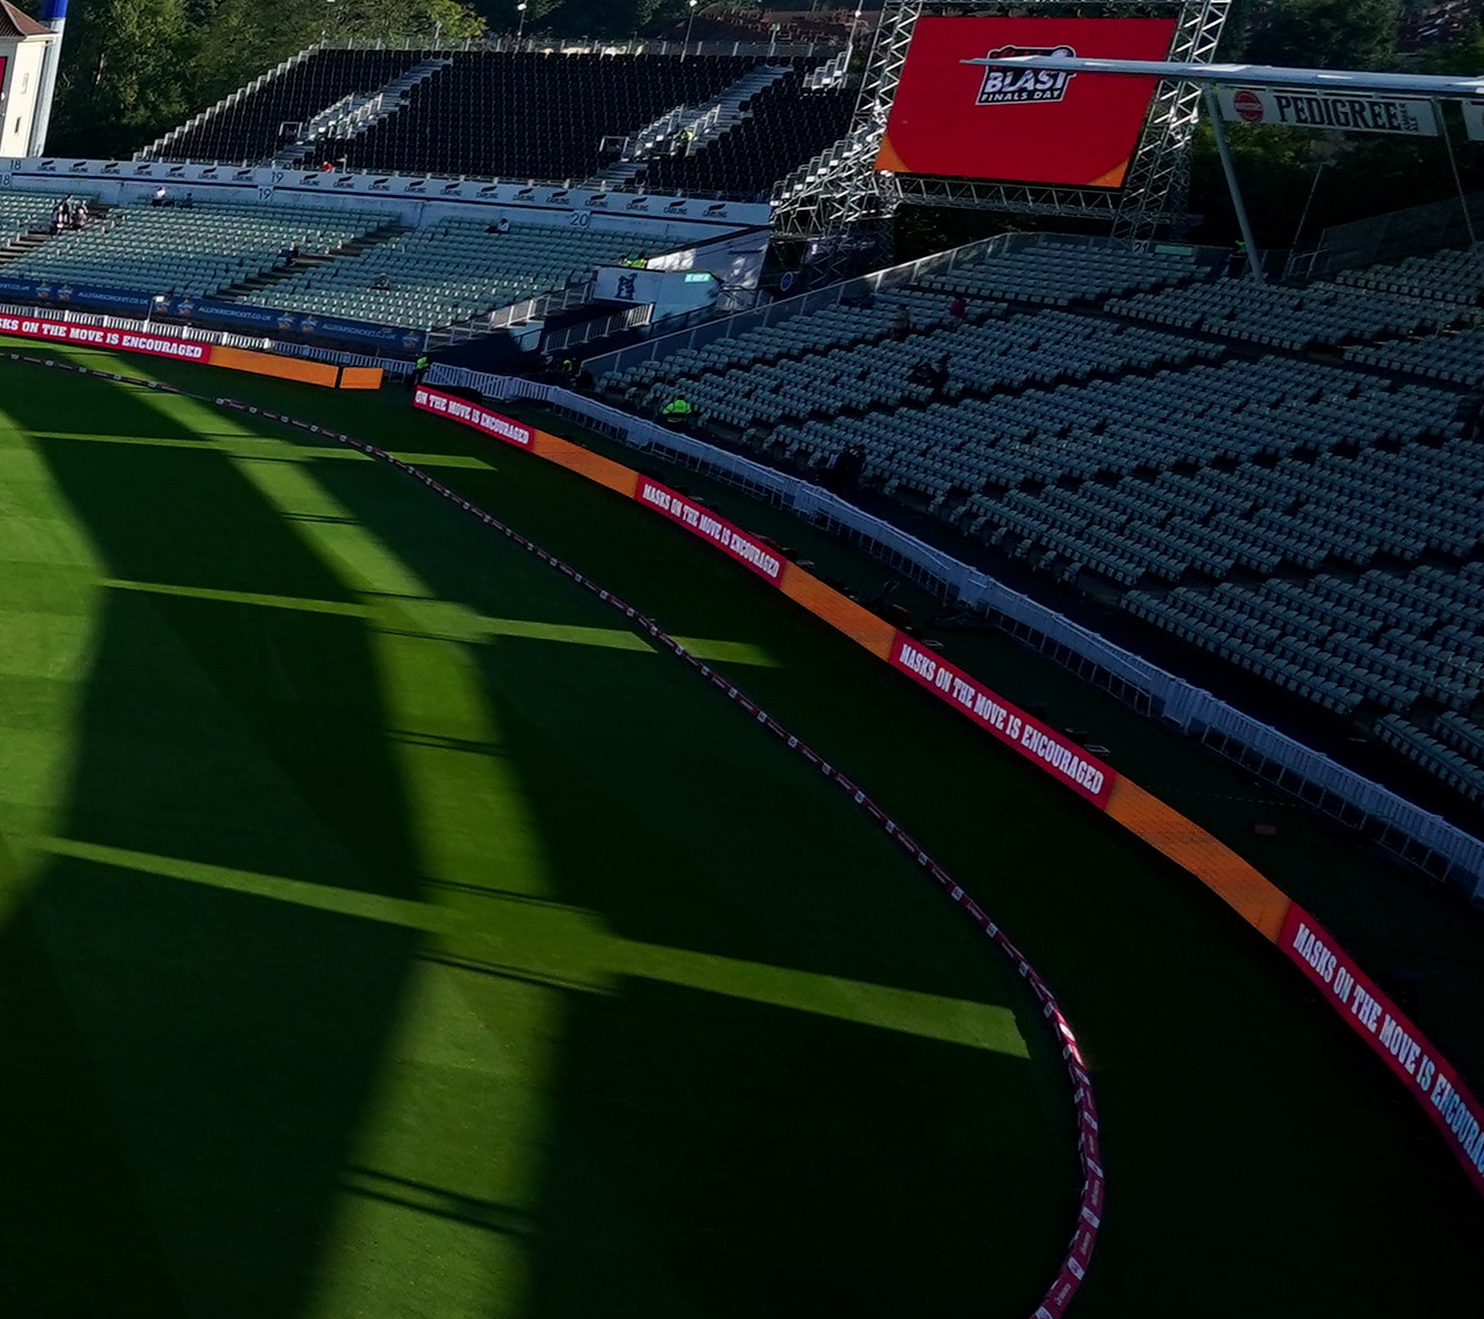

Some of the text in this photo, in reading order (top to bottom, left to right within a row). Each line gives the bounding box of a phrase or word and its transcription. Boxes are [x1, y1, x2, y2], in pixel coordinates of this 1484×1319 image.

[984, 69, 1067, 92] BLAST
[981, 90, 1061, 101] FINALS DAY
[1274, 95, 1401, 130] PEDIGREE
[10, 159, 21, 170] 18
[0, 175, 10, 186] 18
[271, 171, 284, 183] 19
[259, 188, 272, 200] 19
[570, 212, 589, 227] 20
[1134, 242, 1148, 253] 21
[22, 321, 39, 333] ON
[41, 324, 67, 338] THE
[69, 327, 103, 343] MOVE
[105, 333, 119, 345] IS
[122, 336, 203, 358] ENCOURAGED
[899, 644, 1104, 794] MASKS ON THE MOVE IS ENCOURAGED
[1293, 923, 1337, 983] MASKS
[1333, 967, 1354, 1003] ON
[1352, 985, 1382, 1033] THE
[1379, 1014, 1421, 1075] MOVE
[1416, 1055, 1436, 1092] IS
